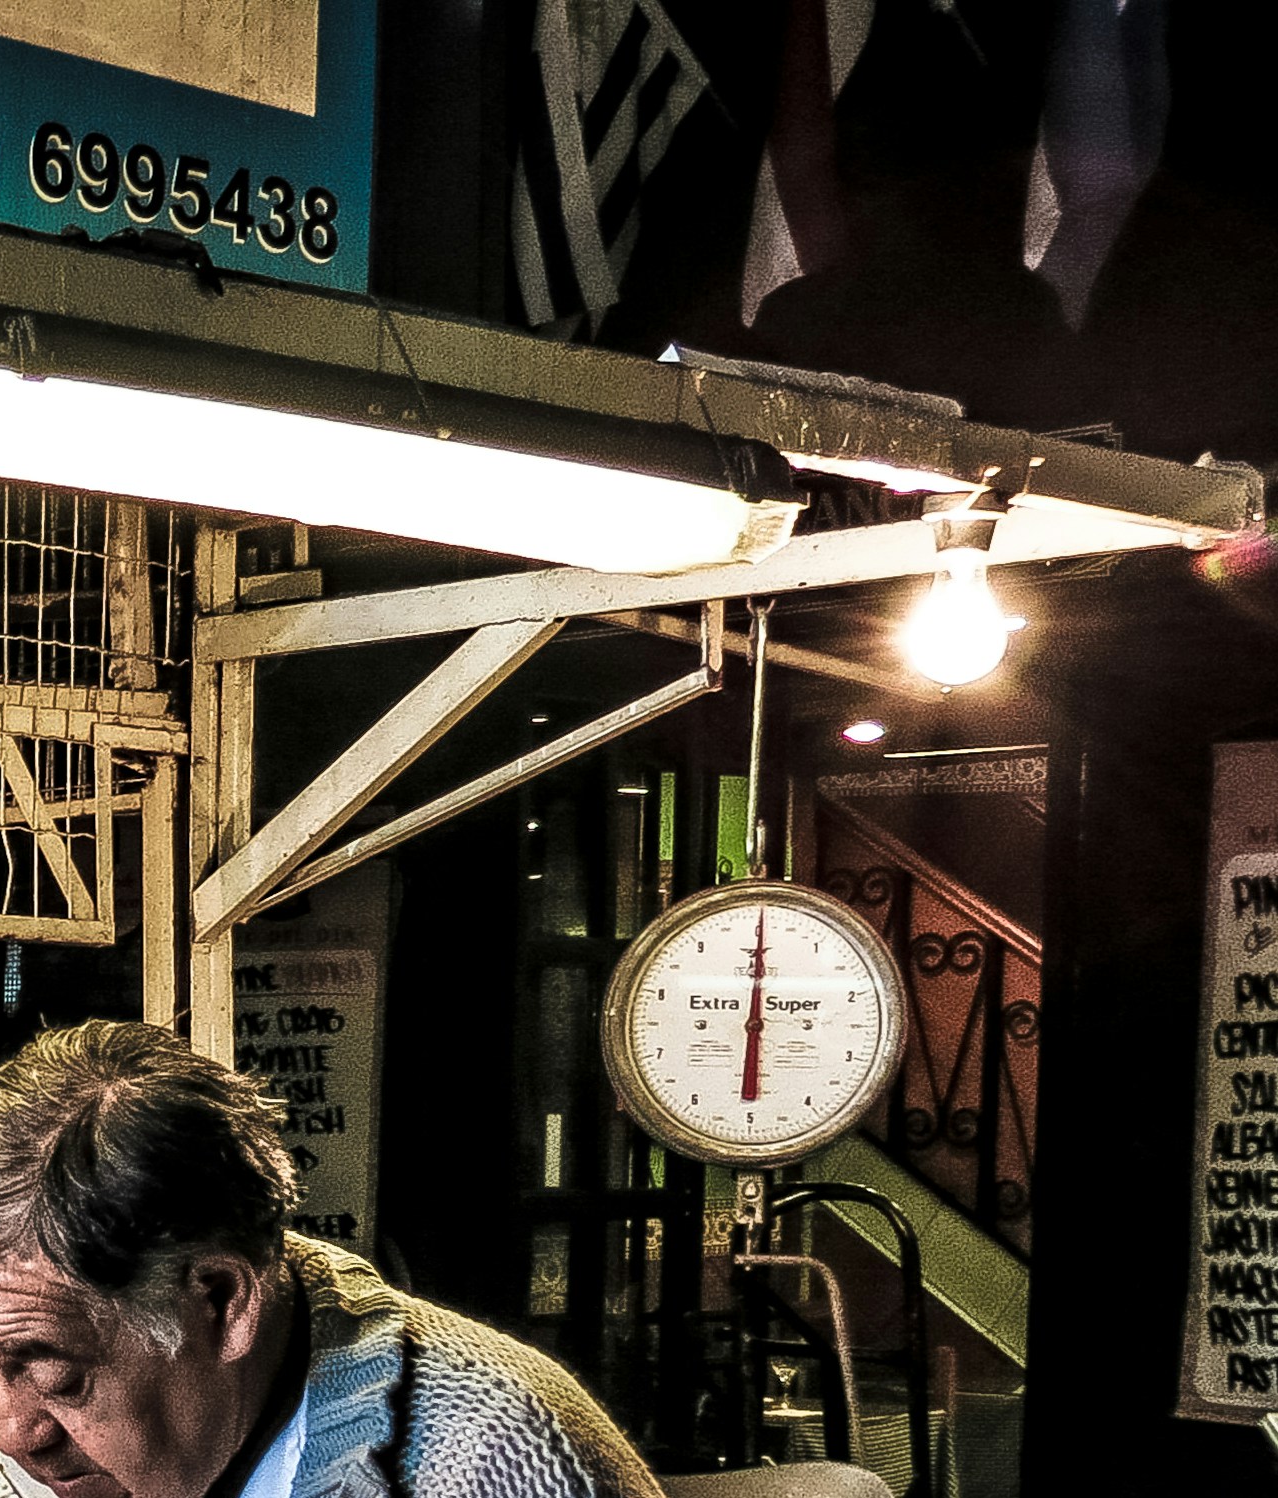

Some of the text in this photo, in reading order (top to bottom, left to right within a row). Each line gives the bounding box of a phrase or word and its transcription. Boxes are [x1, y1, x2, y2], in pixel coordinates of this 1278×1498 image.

[30, 121, 339, 265] 6995438
[689, 995, 821, 1014] Extra Super
